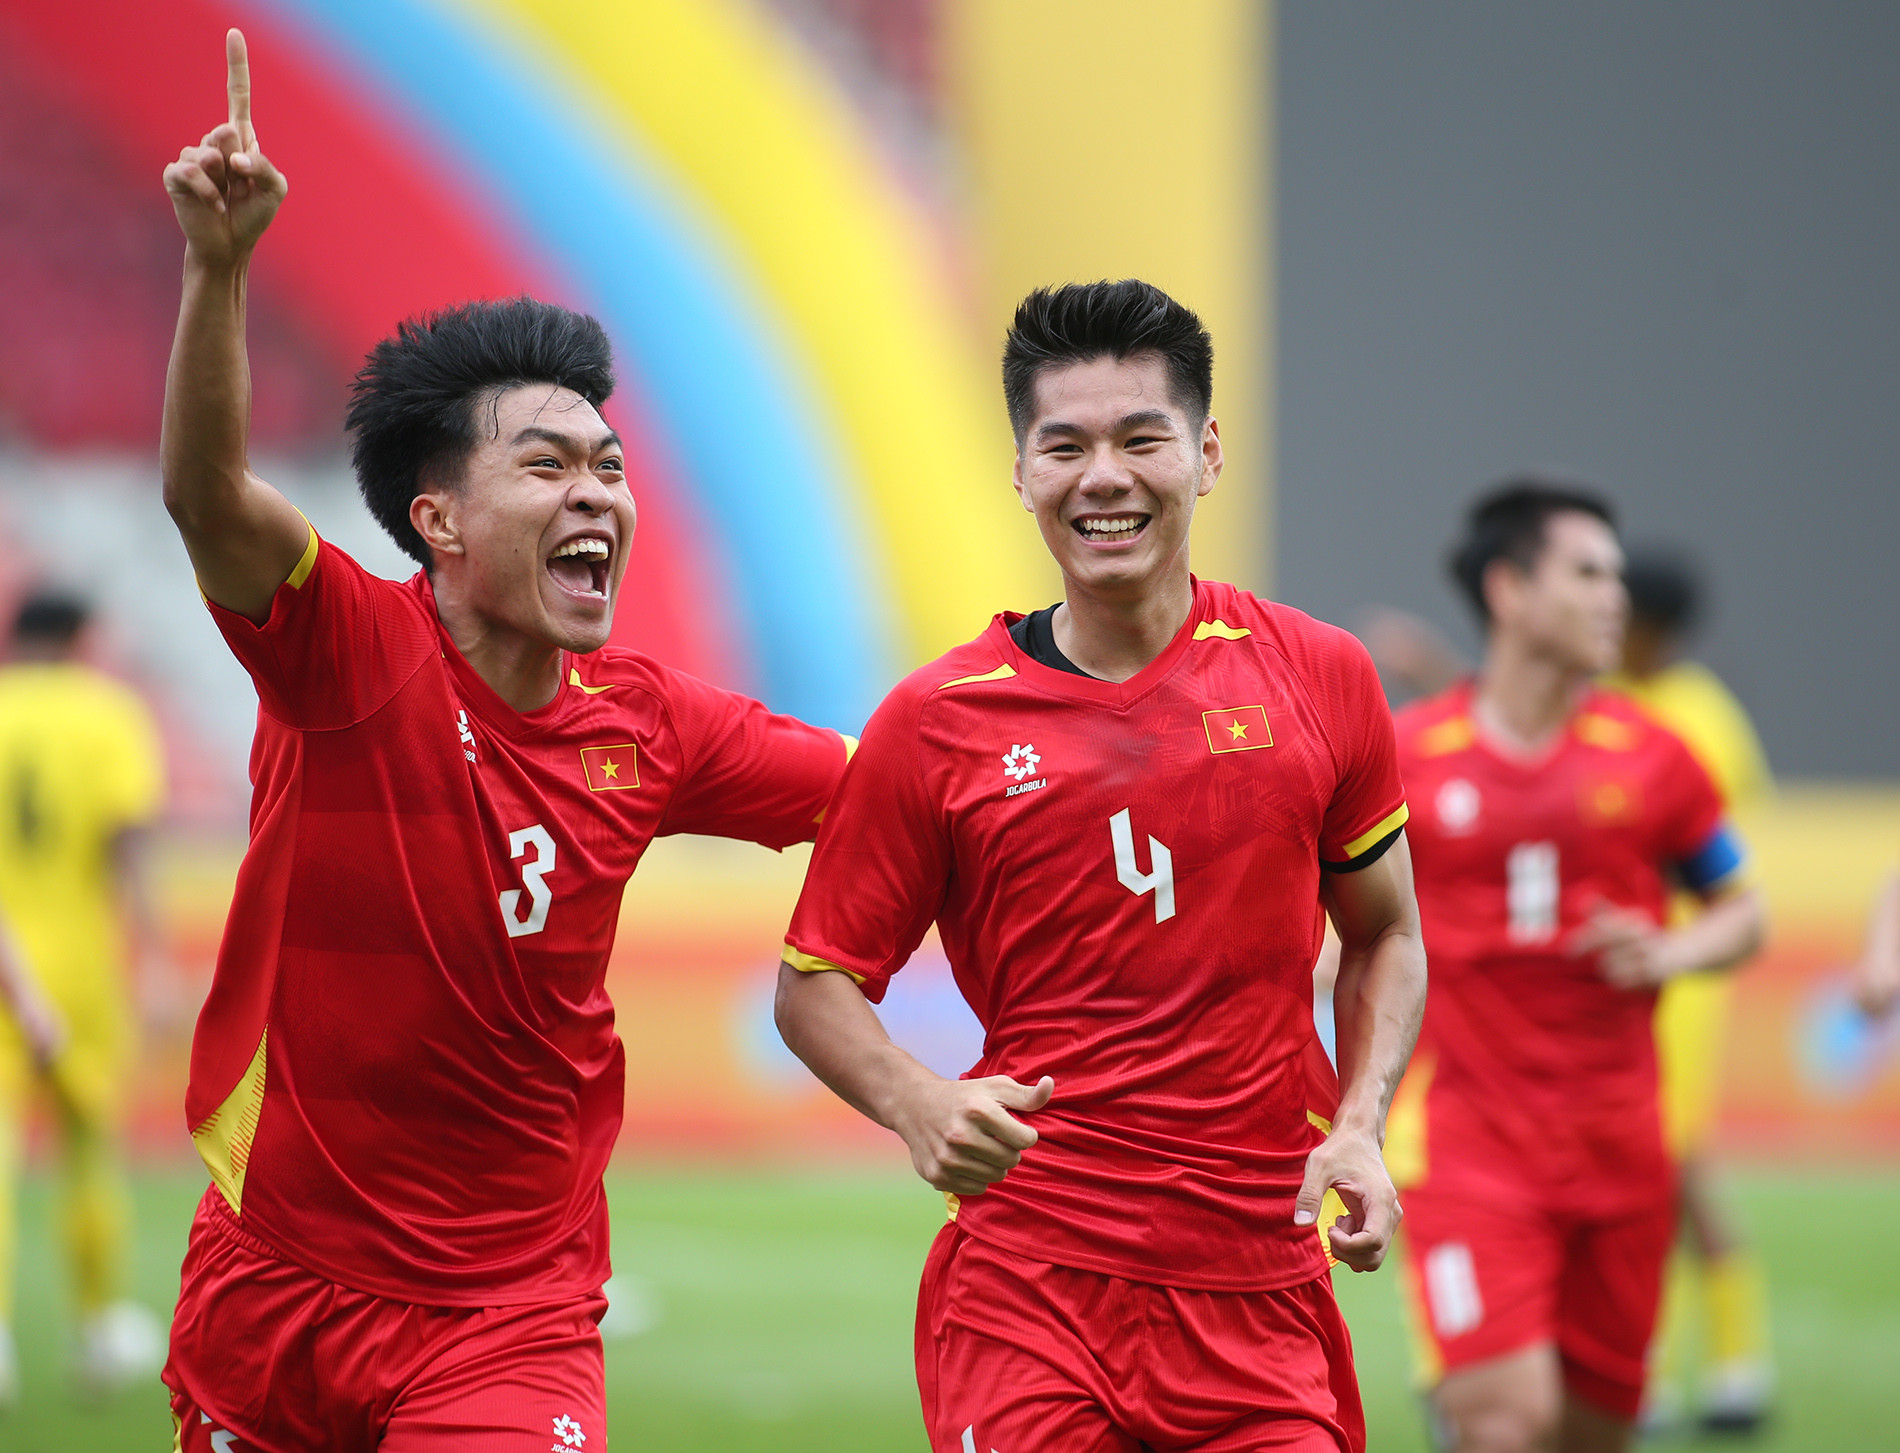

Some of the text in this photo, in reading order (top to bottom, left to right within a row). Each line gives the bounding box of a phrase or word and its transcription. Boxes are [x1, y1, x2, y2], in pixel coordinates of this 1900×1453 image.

[1005, 777, 1047, 798] JOGARBOLA
[498, 823, 557, 938] 3
[1108, 806, 1176, 925] 4
